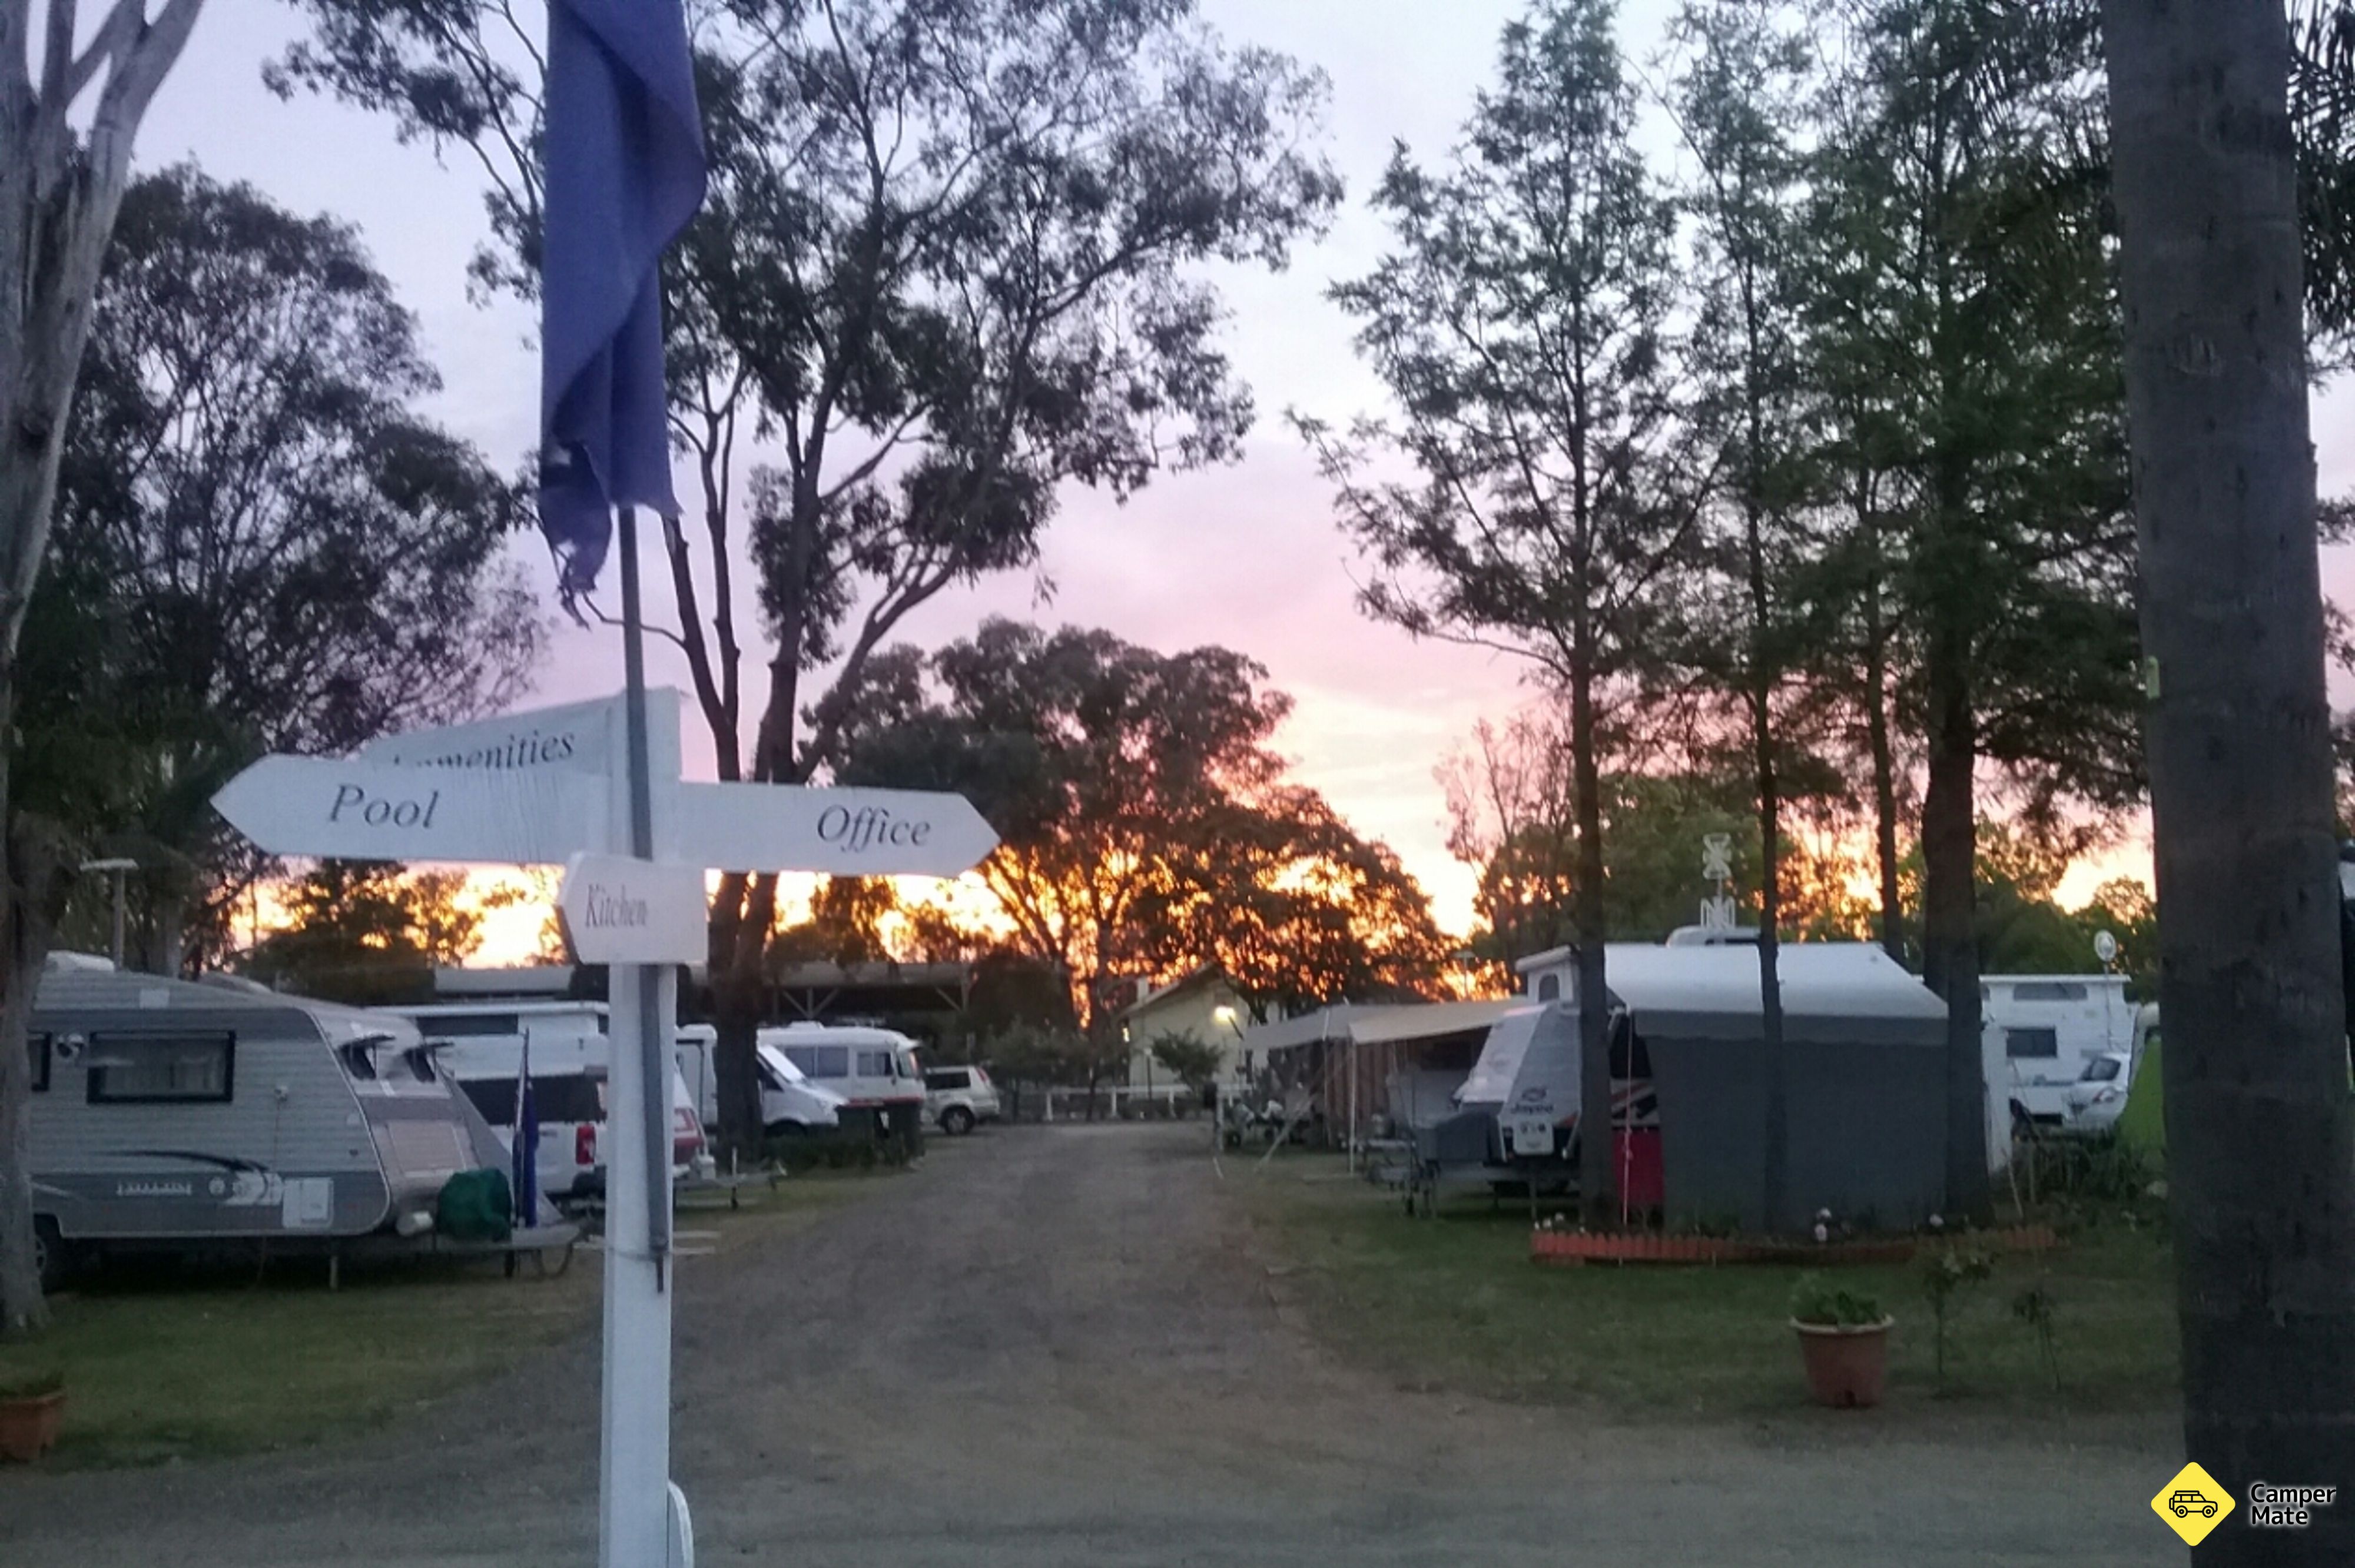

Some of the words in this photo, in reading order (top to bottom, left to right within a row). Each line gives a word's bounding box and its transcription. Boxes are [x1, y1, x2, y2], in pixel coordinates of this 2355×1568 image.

[393, 730, 575, 768] enities
[327, 784, 439, 828] Pool
[817, 804, 930, 853] Office
[585, 883, 648, 928] Kitchen
